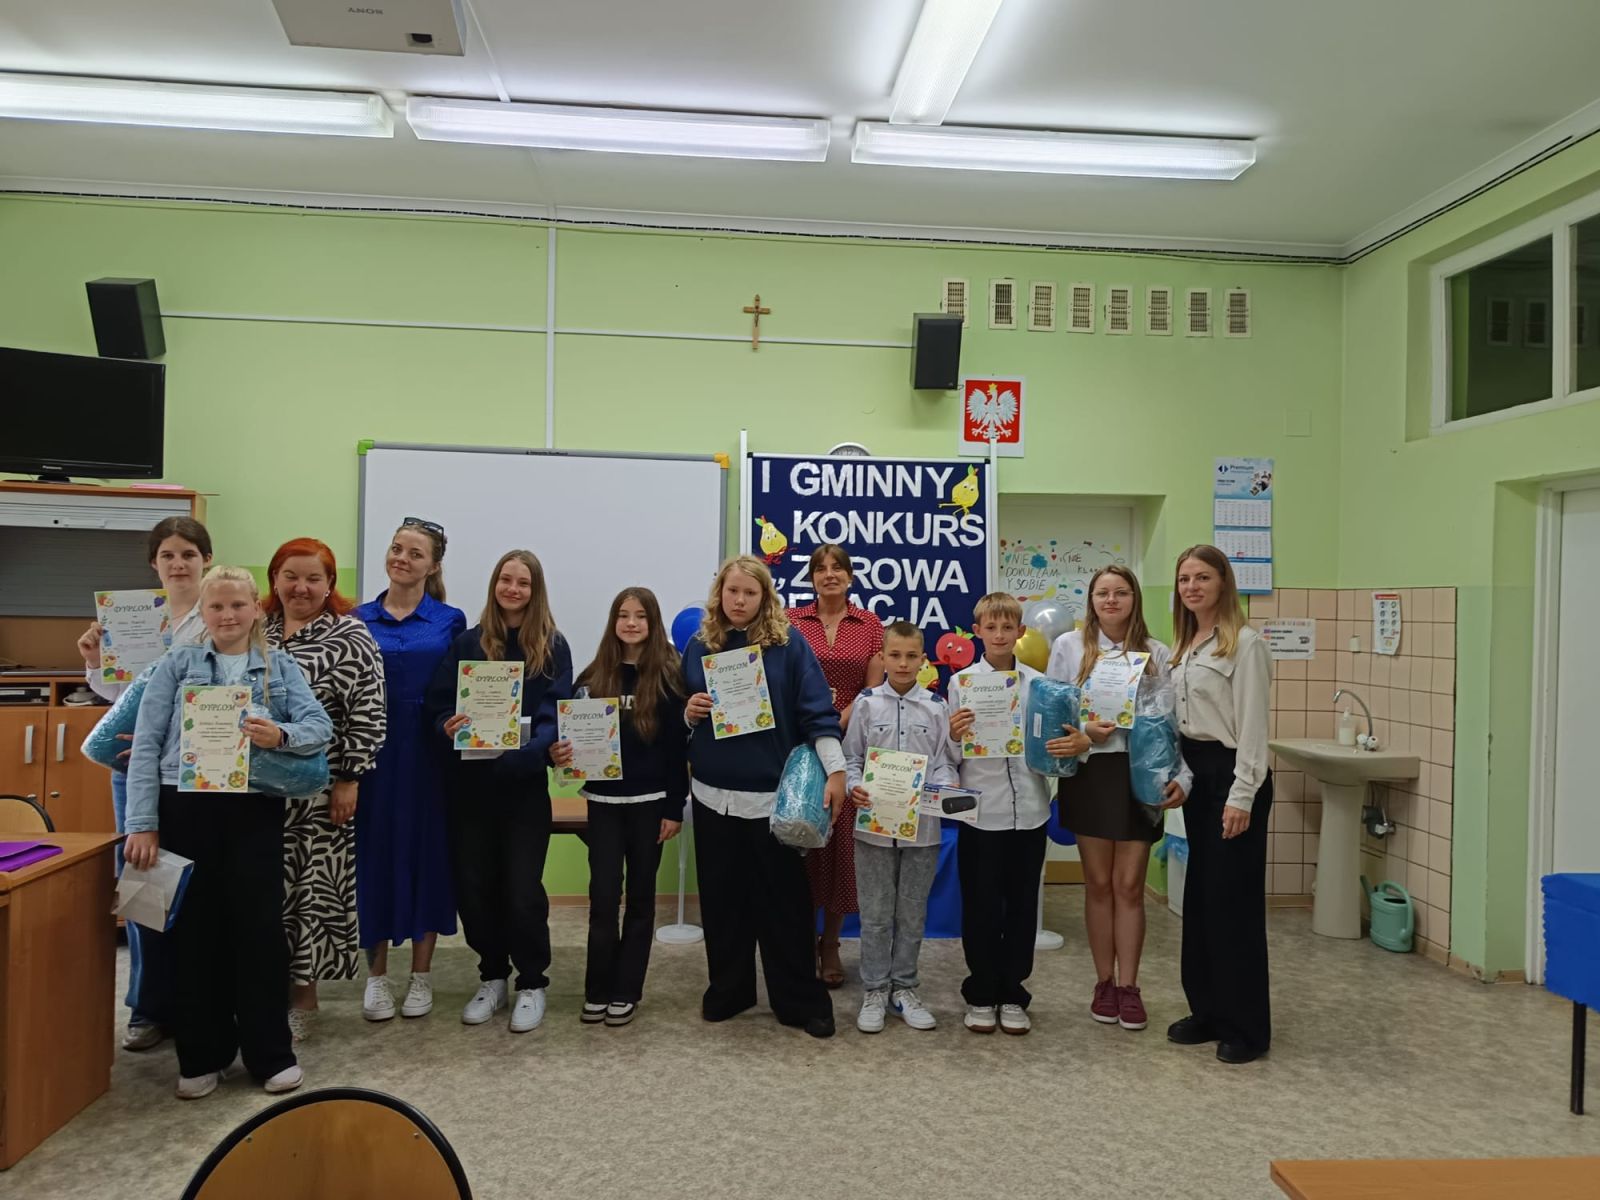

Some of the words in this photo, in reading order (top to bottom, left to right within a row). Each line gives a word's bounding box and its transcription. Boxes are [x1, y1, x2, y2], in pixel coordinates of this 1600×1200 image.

[348, 7, 384, 15] SONY
[761, 460, 771, 493] I
[789, 461, 955, 499] GMINNY
[792, 510, 985, 547] KONKURS
[773, 554, 969, 593] „ZROWA
[1015, 579, 1046, 591] SOBIE
[114, 604, 152, 613] DYPLOM
[776, 593, 950, 629] ACJA
[718, 662, 748, 673] DYPLOM
[973, 685, 1005, 693] DYPLOM
[199, 703, 235, 711] DYPLOM
[572, 712, 604, 720] DYPLOM
[881, 762, 913, 773] DYPLOM
